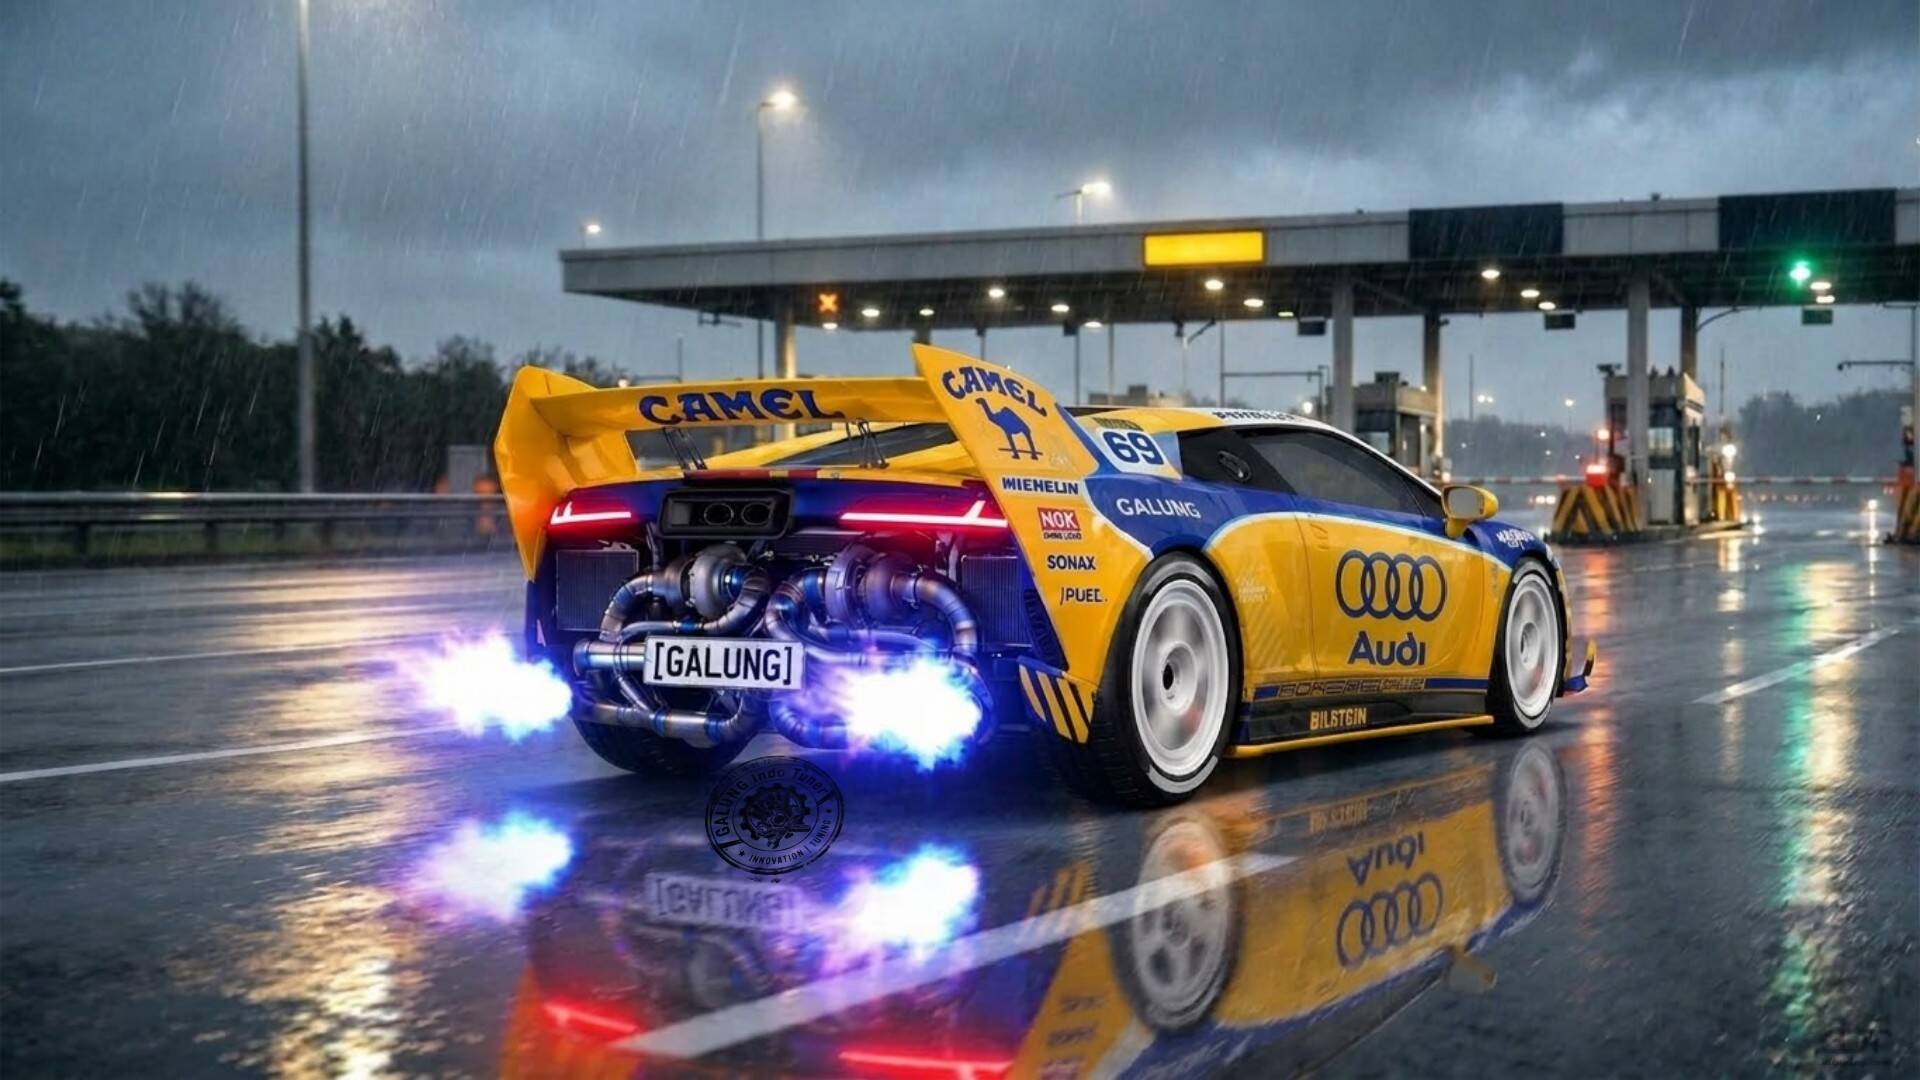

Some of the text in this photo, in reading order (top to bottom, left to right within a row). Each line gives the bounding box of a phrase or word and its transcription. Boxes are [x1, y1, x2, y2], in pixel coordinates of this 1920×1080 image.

[639, 388, 845, 425] CAMEL
[942, 366, 1047, 417] CAMEL
[1103, 431, 1164, 464] 69
[1116, 498, 1201, 519] GALUNG
[1047, 555, 1096, 570] SONAX
[652, 642, 793, 685] [GALUNG]
[1348, 632, 1426, 666] Audi
